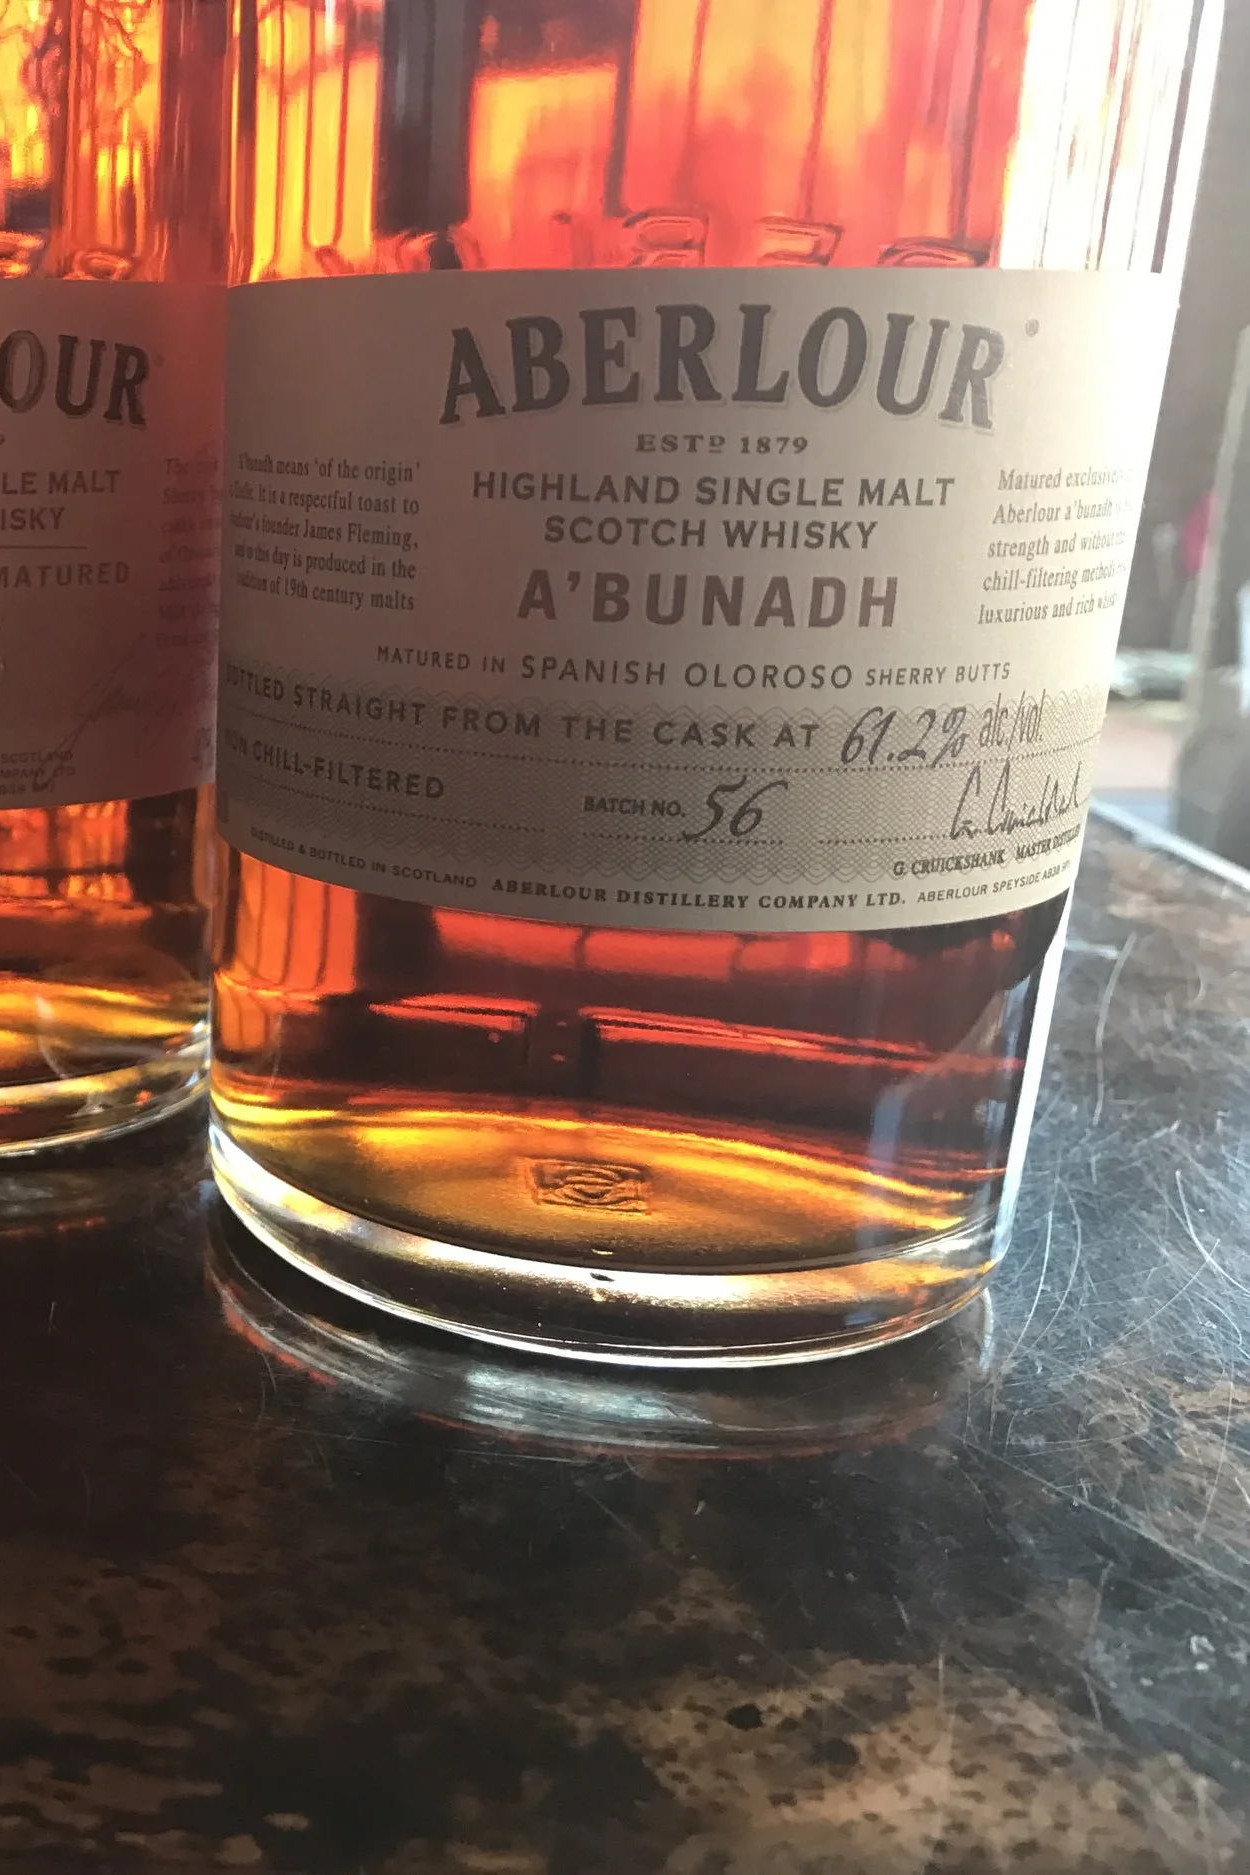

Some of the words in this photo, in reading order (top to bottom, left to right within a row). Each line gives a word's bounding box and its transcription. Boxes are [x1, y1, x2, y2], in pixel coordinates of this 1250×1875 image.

[439, 303, 1007, 433] ABERLOUR
[740, 435, 809, 455] 1879
[47, 469, 121, 496] MALT
[276, 458, 310, 477] means
[337, 458, 360, 479] the
[364, 459, 421, 486] origin'
[473, 471, 680, 505] HIGHLAND
[695, 477, 843, 508] SINGLE
[857, 477, 956, 507] MALT
[998, 467, 1063, 491] Matured
[289, 489, 352, 513] respectful
[358, 495, 397, 514] toast
[403, 496, 420, 516] to
[992, 502, 1061, 525] Aberlour
[262, 513, 300, 537] founder
[303, 518, 343, 542] James
[347, 522, 419, 553] Fleming,
[544, 515, 706, 548] SCOTCH
[722, 520, 879, 549] WHISKY
[987, 534, 1050, 562] strength
[1054, 532, 1078, 554] and
[272, 543, 290, 571] day
[293, 548, 302, 568] is
[305, 552, 367, 575] produced
[371, 556, 386, 577] in
[391, 557, 417, 580] the
[982, 565, 1079, 592] chill-filtering
[269, 575, 282, 596] of
[283, 577, 309, 600] 19th
[312, 585, 364, 612] century
[370, 588, 415, 612] malts
[516, 568, 899, 628] A'BUNADH
[977, 601, 1049, 625] luxurious
[1052, 597, 1075, 619] and
[1075, 593, 1095, 615] rich
[376, 645, 470, 671] MATURED
[482, 656, 506, 674] IN
[521, 654, 666, 685] SPANISH
[684, 661, 853, 689] OLOROSO
[865, 666, 948, 687] SHERRY
[955, 662, 1010, 684] BUTTS
[293, 686, 427, 726] STRAIGHT
[442, 705, 542, 738] FROM
[561, 715, 634, 744] THE
[652, 719, 756, 748] CASK
[773, 723, 820, 749] AT
[840, 707, 969, 768] 61.2%
[253, 741, 445, 799] CHILL-FILTERED
[583, 795, 647, 815] BATCH
[651, 799, 686, 819] NO.
[682, 774, 789, 842] 56
[911, 849, 1006, 876] CRUICKSHANK
[1014, 840, 1051, 861] MASTER
[309, 847, 366, 870] BOTTLED
[371, 861, 387, 874] IN
[391, 865, 478, 889] SCOTLAND
[491, 878, 608, 903] ABERLOUR
[617, 889, 749, 909] DISTILLERY
[758, 893, 858, 910] COMPANY
[866, 891, 906, 908] LTD.
[917, 883, 988, 904] ABERLOUR
[992, 873, 1041, 894] SPEYSIDE
